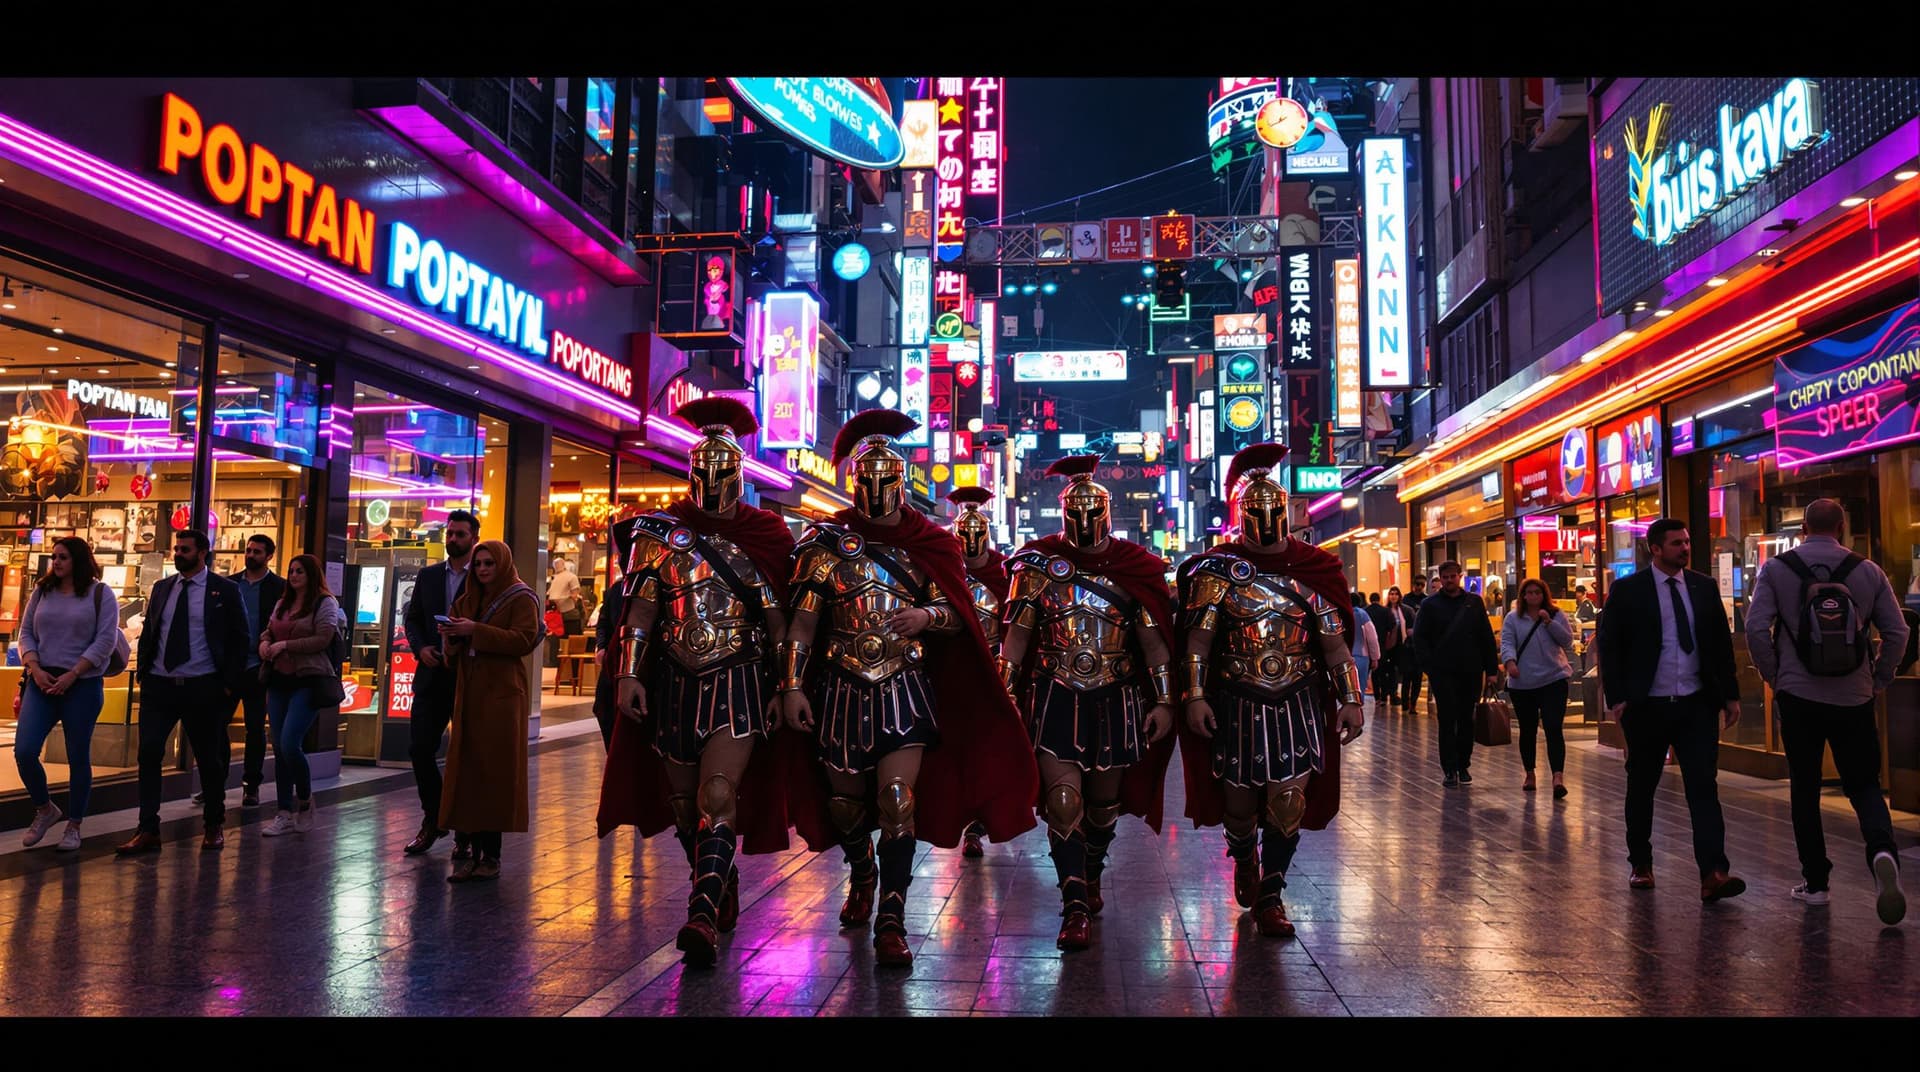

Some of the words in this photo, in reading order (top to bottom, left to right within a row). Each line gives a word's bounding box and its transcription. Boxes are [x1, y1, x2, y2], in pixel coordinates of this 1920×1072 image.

[1719, 77, 1813, 195] kava
[158, 92, 376, 275] POPTAN
[67, 379, 136, 413] POPTAN
[138, 396, 168, 419] TAN
[553, 329, 632, 399] POPORTANG
[1816, 392, 1881, 437] SPEER
